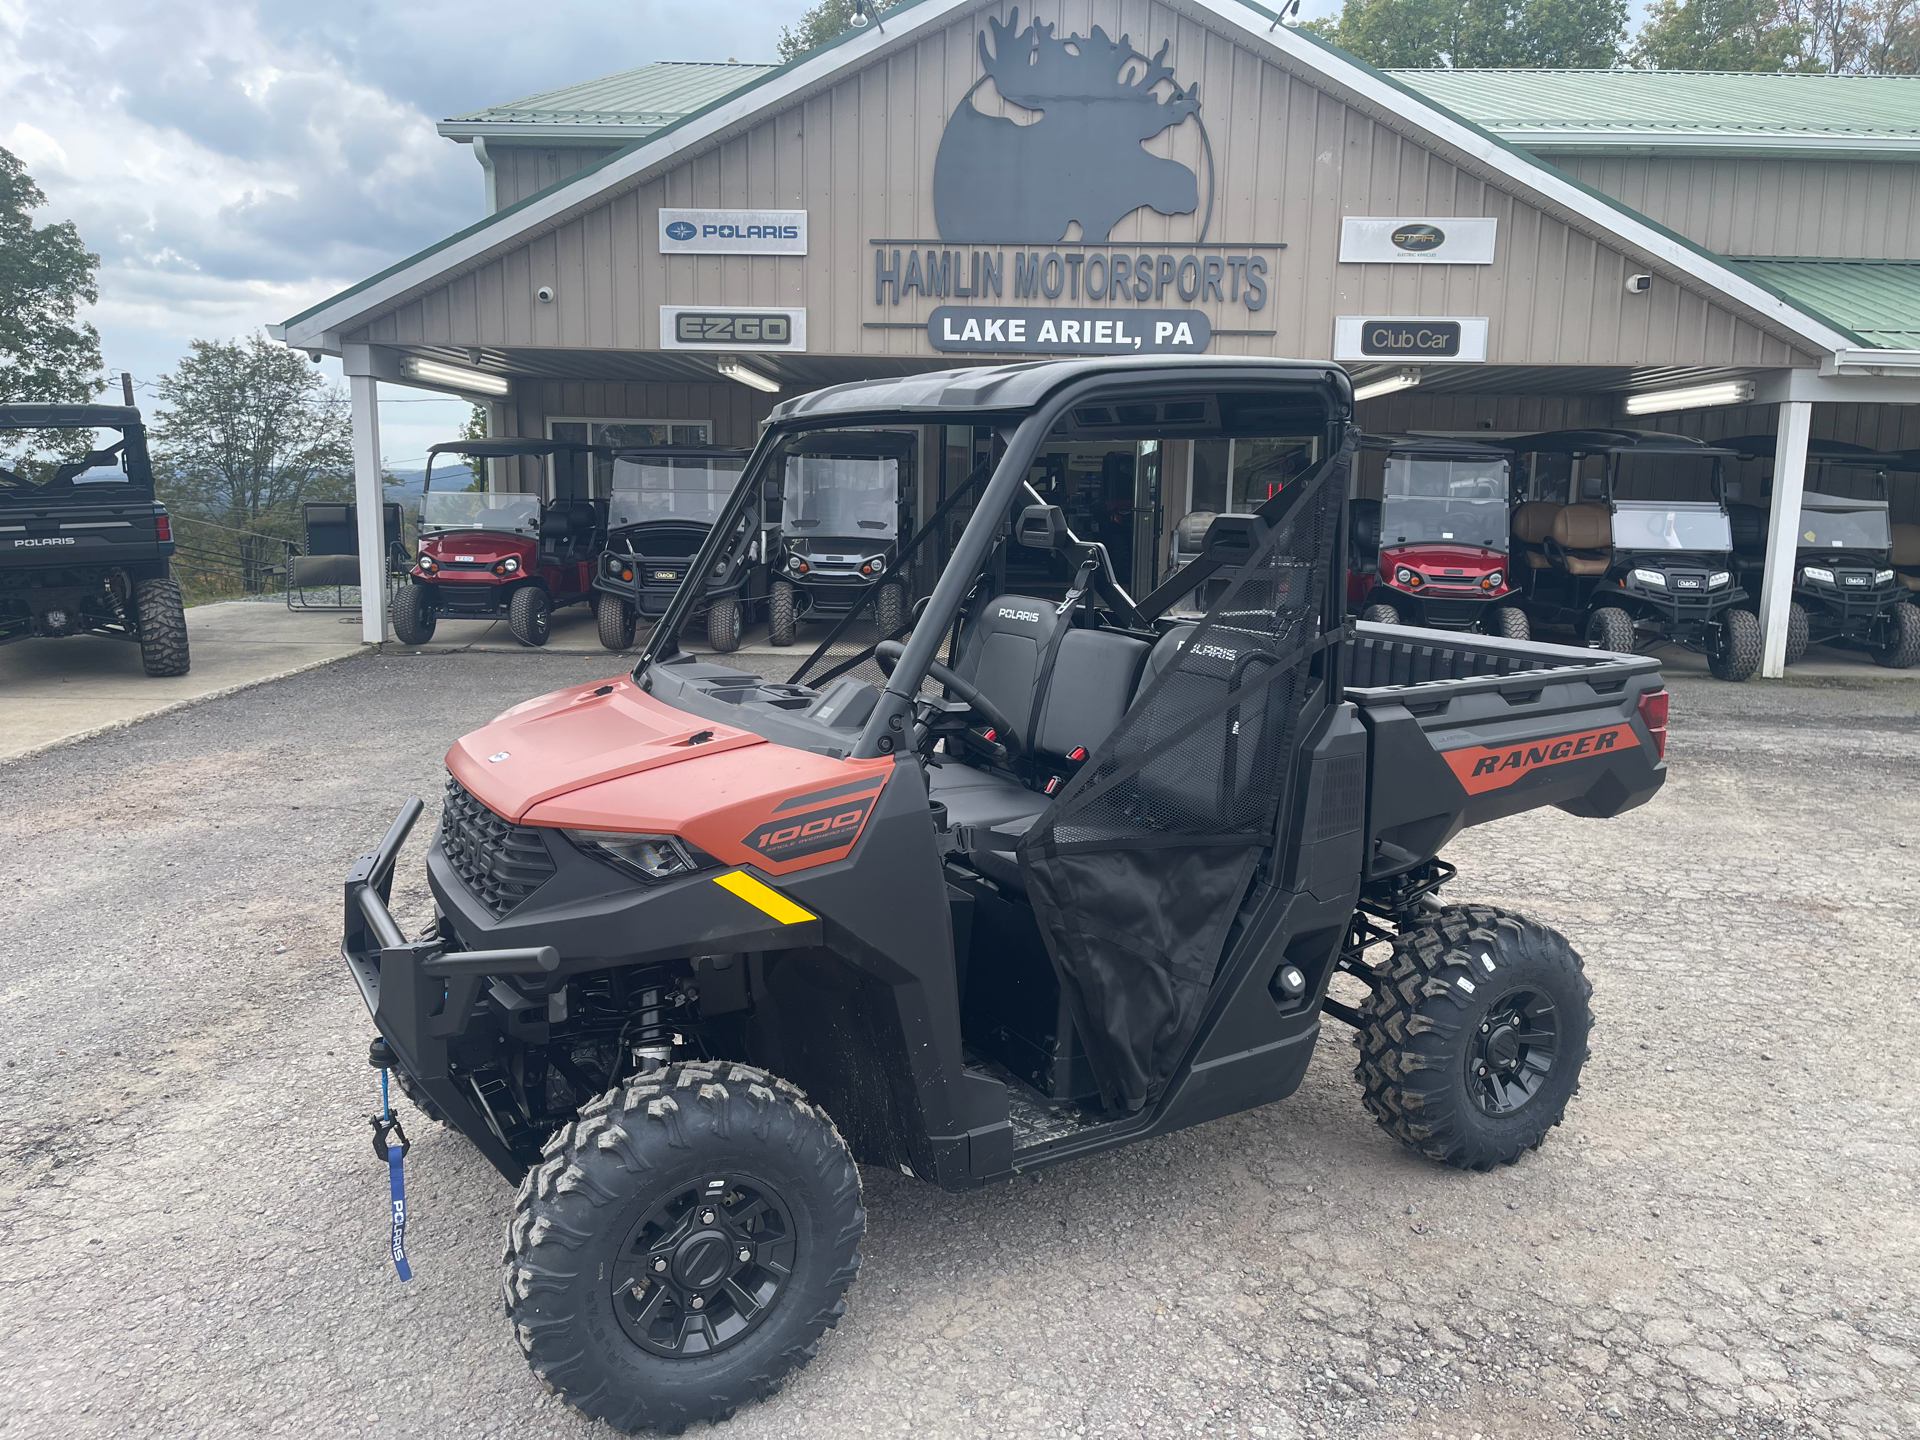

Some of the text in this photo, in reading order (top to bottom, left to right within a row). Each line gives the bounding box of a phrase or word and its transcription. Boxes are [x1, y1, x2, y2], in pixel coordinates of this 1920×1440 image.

[702, 225, 798, 239] POLARIS
[1394, 233, 1435, 243] STAR
[875, 249, 1268, 311] HAMLIN MOTORSPORTS
[679, 317, 787, 340] EZGO
[943, 317, 1194, 350] LAKE ARIEL, PA
[1372, 329, 1450, 349] Club Car
[14, 537, 75, 547] POLARIS
[998, 608, 1040, 623] POLARIS
[1471, 731, 1619, 777] RANGER
[757, 809, 863, 848] 1000
[766, 841, 796, 852] SINGLE
[798, 829, 841, 844] OVERHEAD
[392, 1200, 405, 1262] POLARIS
